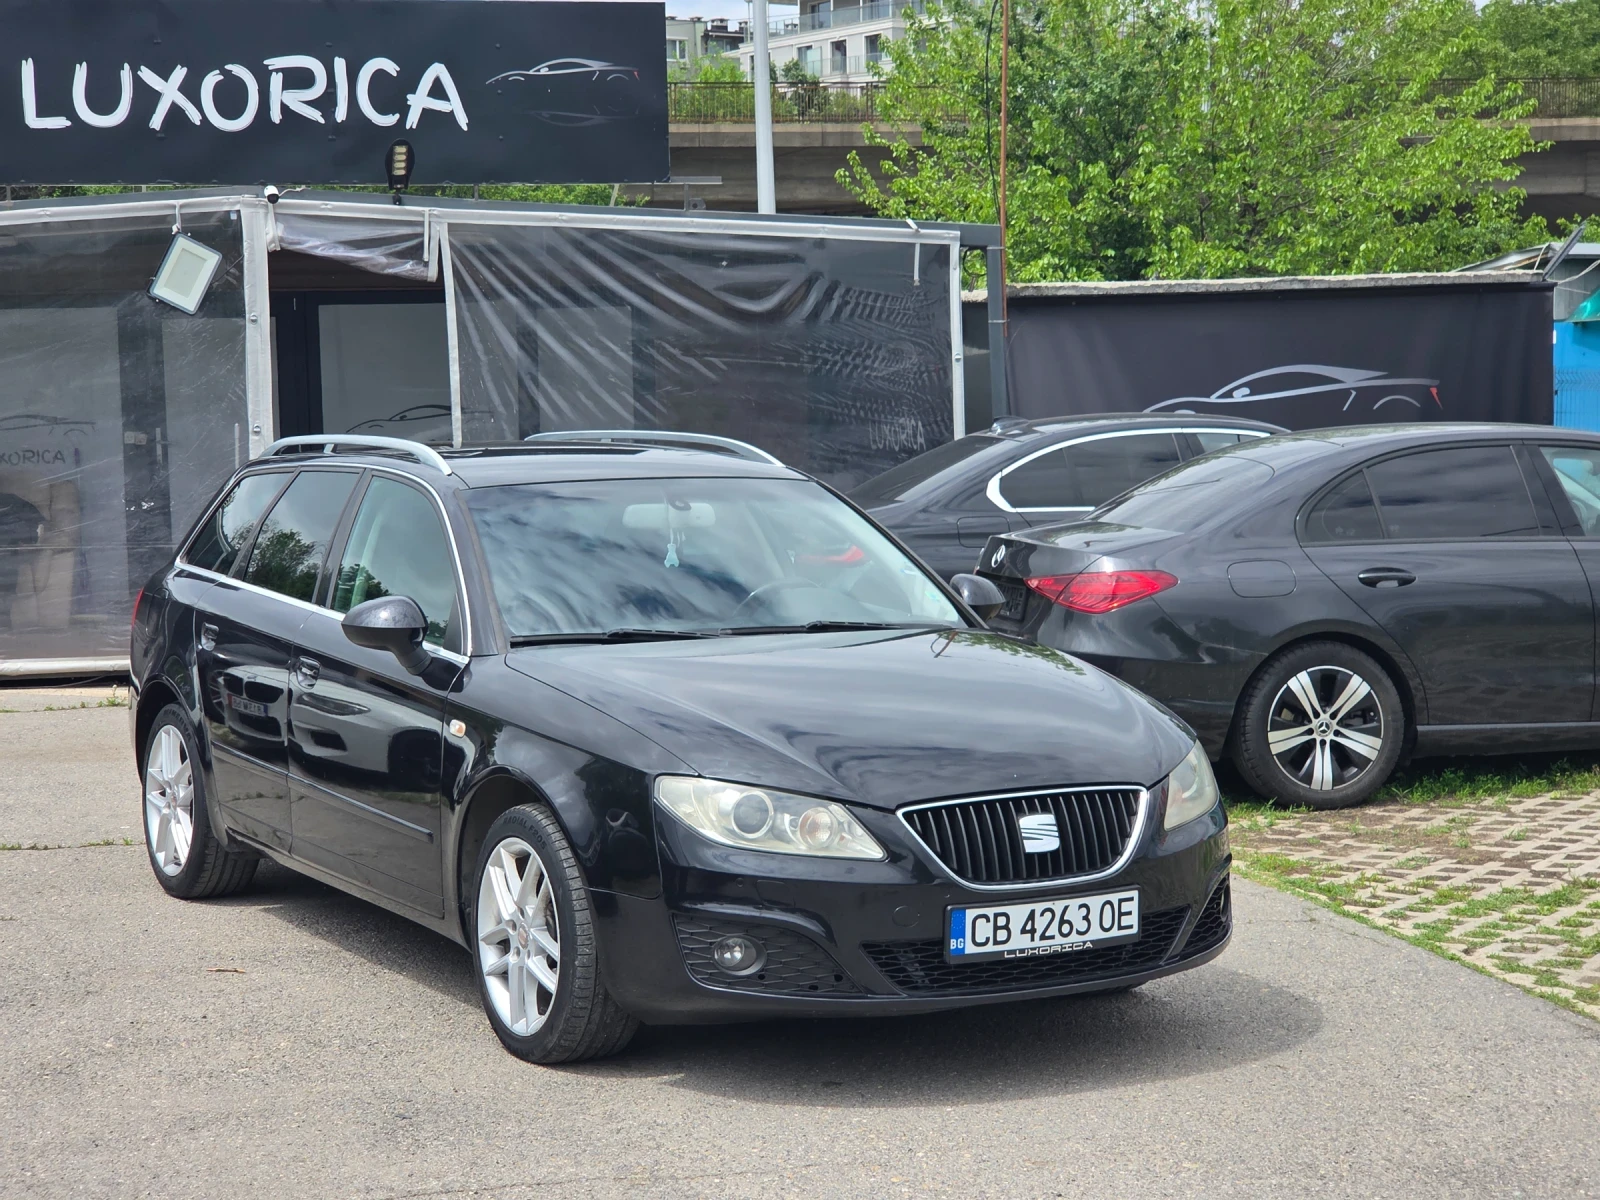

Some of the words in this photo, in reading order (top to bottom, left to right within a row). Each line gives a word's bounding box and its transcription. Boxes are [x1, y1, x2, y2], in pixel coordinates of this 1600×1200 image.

[20, 54, 469, 132] LUXORICA
[869, 417, 926, 451] LUXORICA
[1019, 902, 1092, 944] 4263
[950, 938, 965, 950] BG
[1004, 941, 1094, 958] LUXORICA
